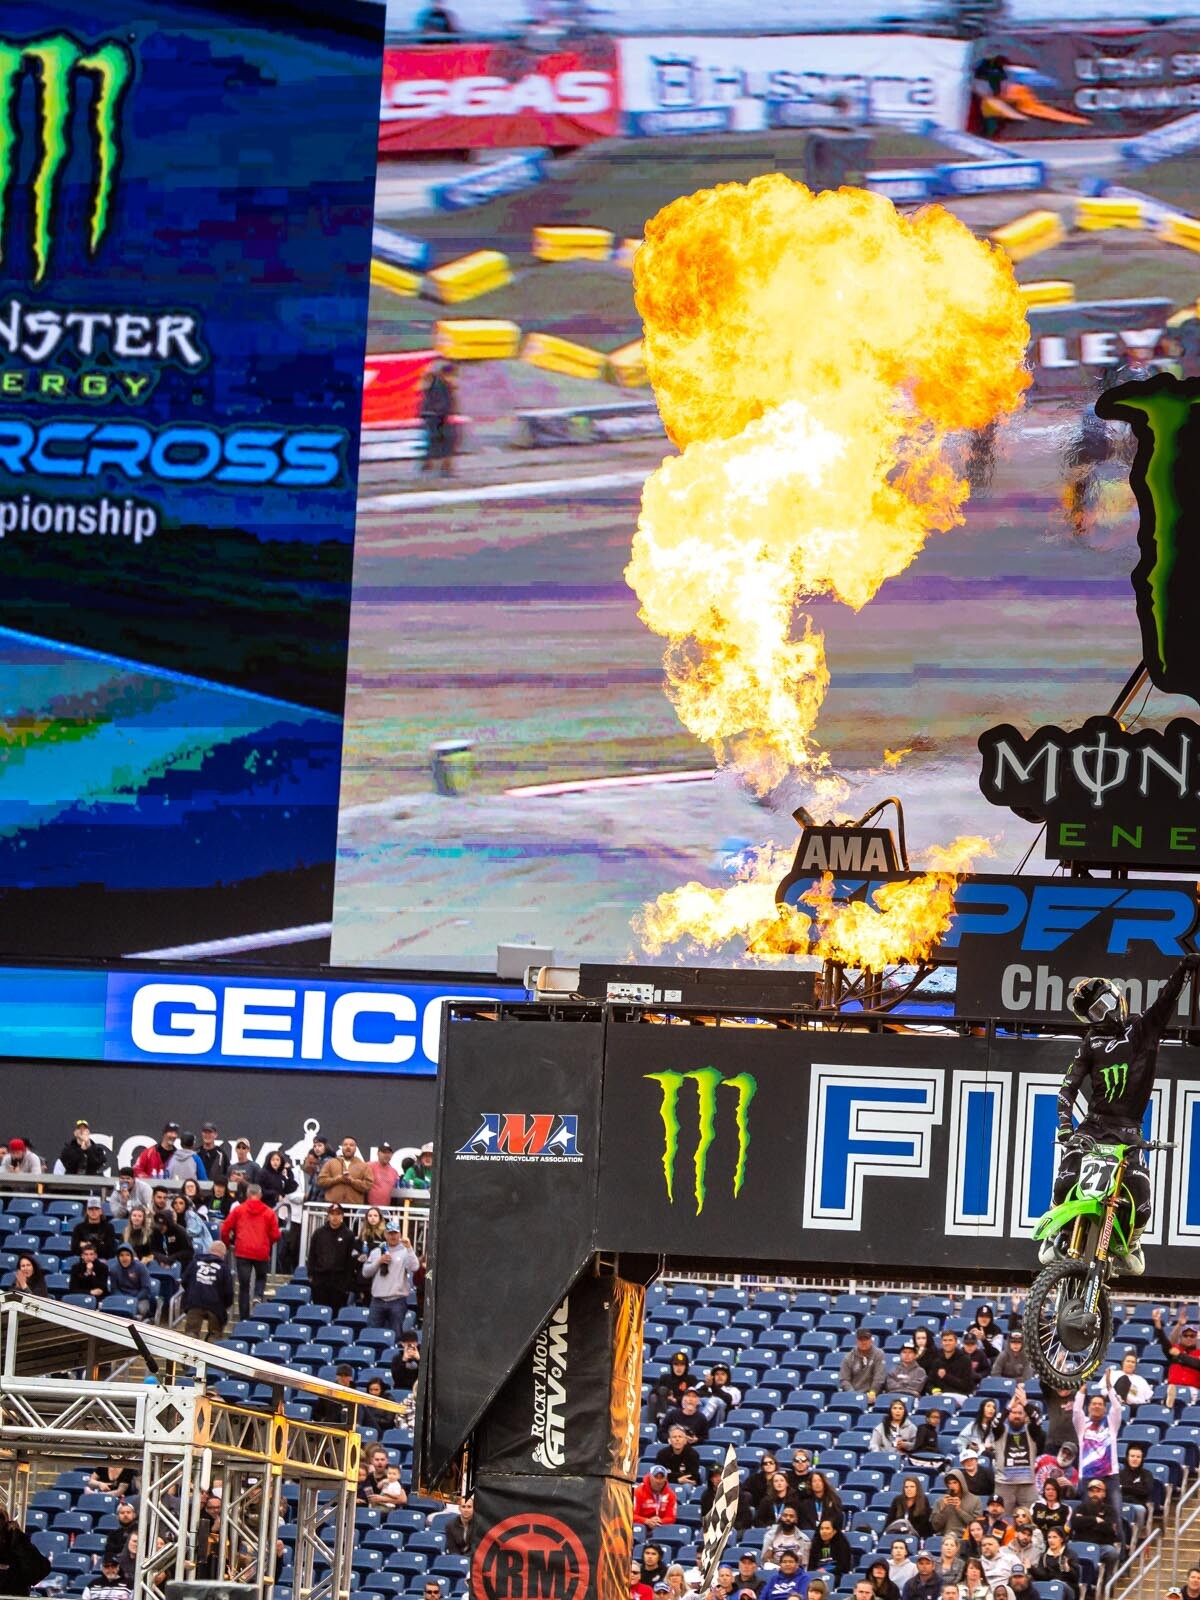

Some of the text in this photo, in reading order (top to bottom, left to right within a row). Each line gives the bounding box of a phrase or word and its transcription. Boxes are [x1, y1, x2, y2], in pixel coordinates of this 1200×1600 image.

[801, 835, 889, 873] AMA
[131, 984, 501, 1065] GEIC
[454, 1113, 584, 1156] AMA
[490, 1155, 540, 1163] MOTORCYCLIST
[1080, 1162, 1116, 1192] 21
[1102, 1215, 1113, 1248] SHOWA
[531, 1379, 546, 1440] ROCKY
[496, 1550, 568, 1598] RM
